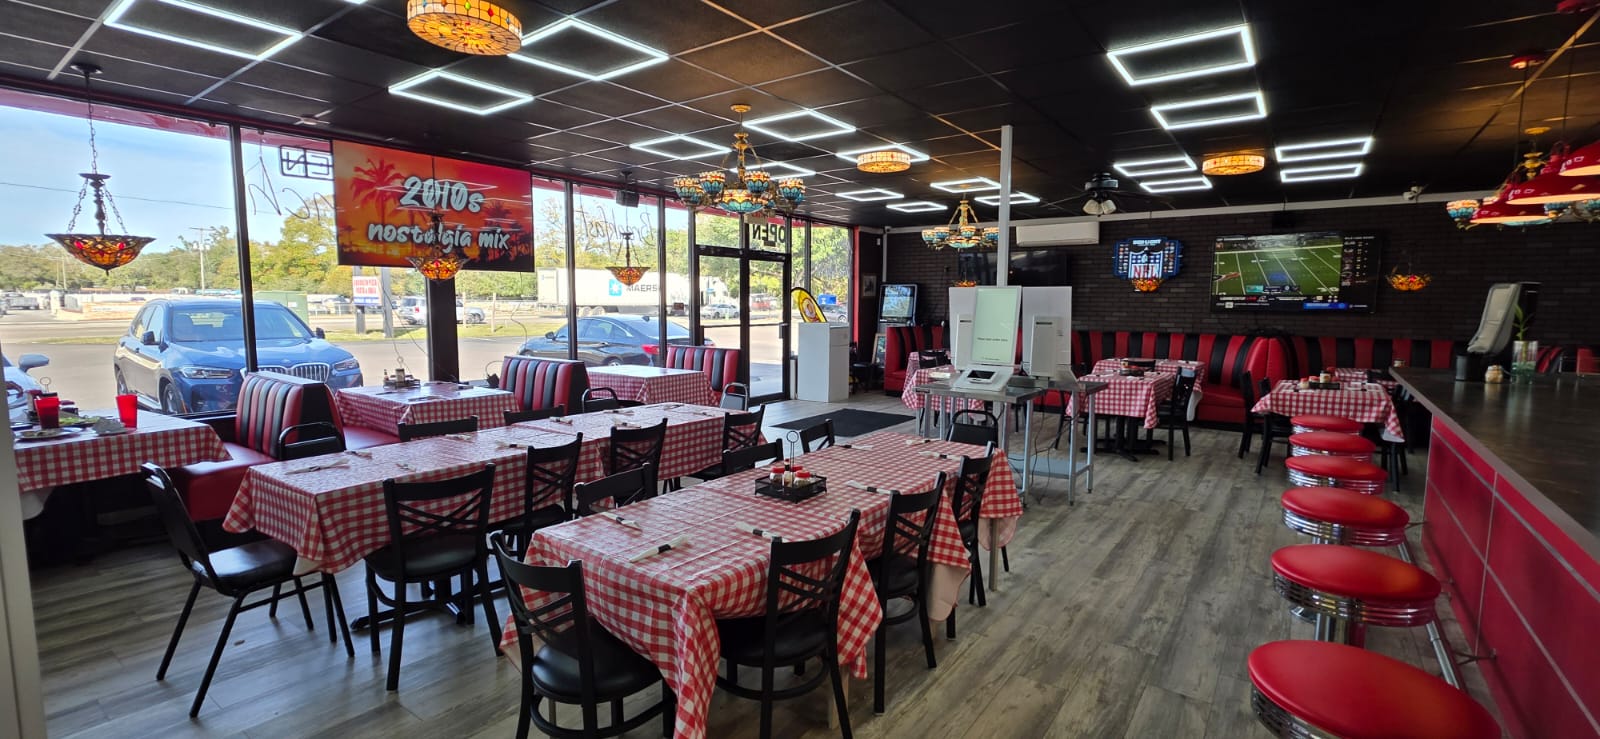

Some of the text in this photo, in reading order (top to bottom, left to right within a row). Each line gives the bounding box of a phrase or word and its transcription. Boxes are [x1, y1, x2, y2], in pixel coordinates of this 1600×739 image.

[400, 176, 484, 213] 2010s
[368, 222, 511, 253] nostalgia mix
[625, 284, 659, 293] MAERS
